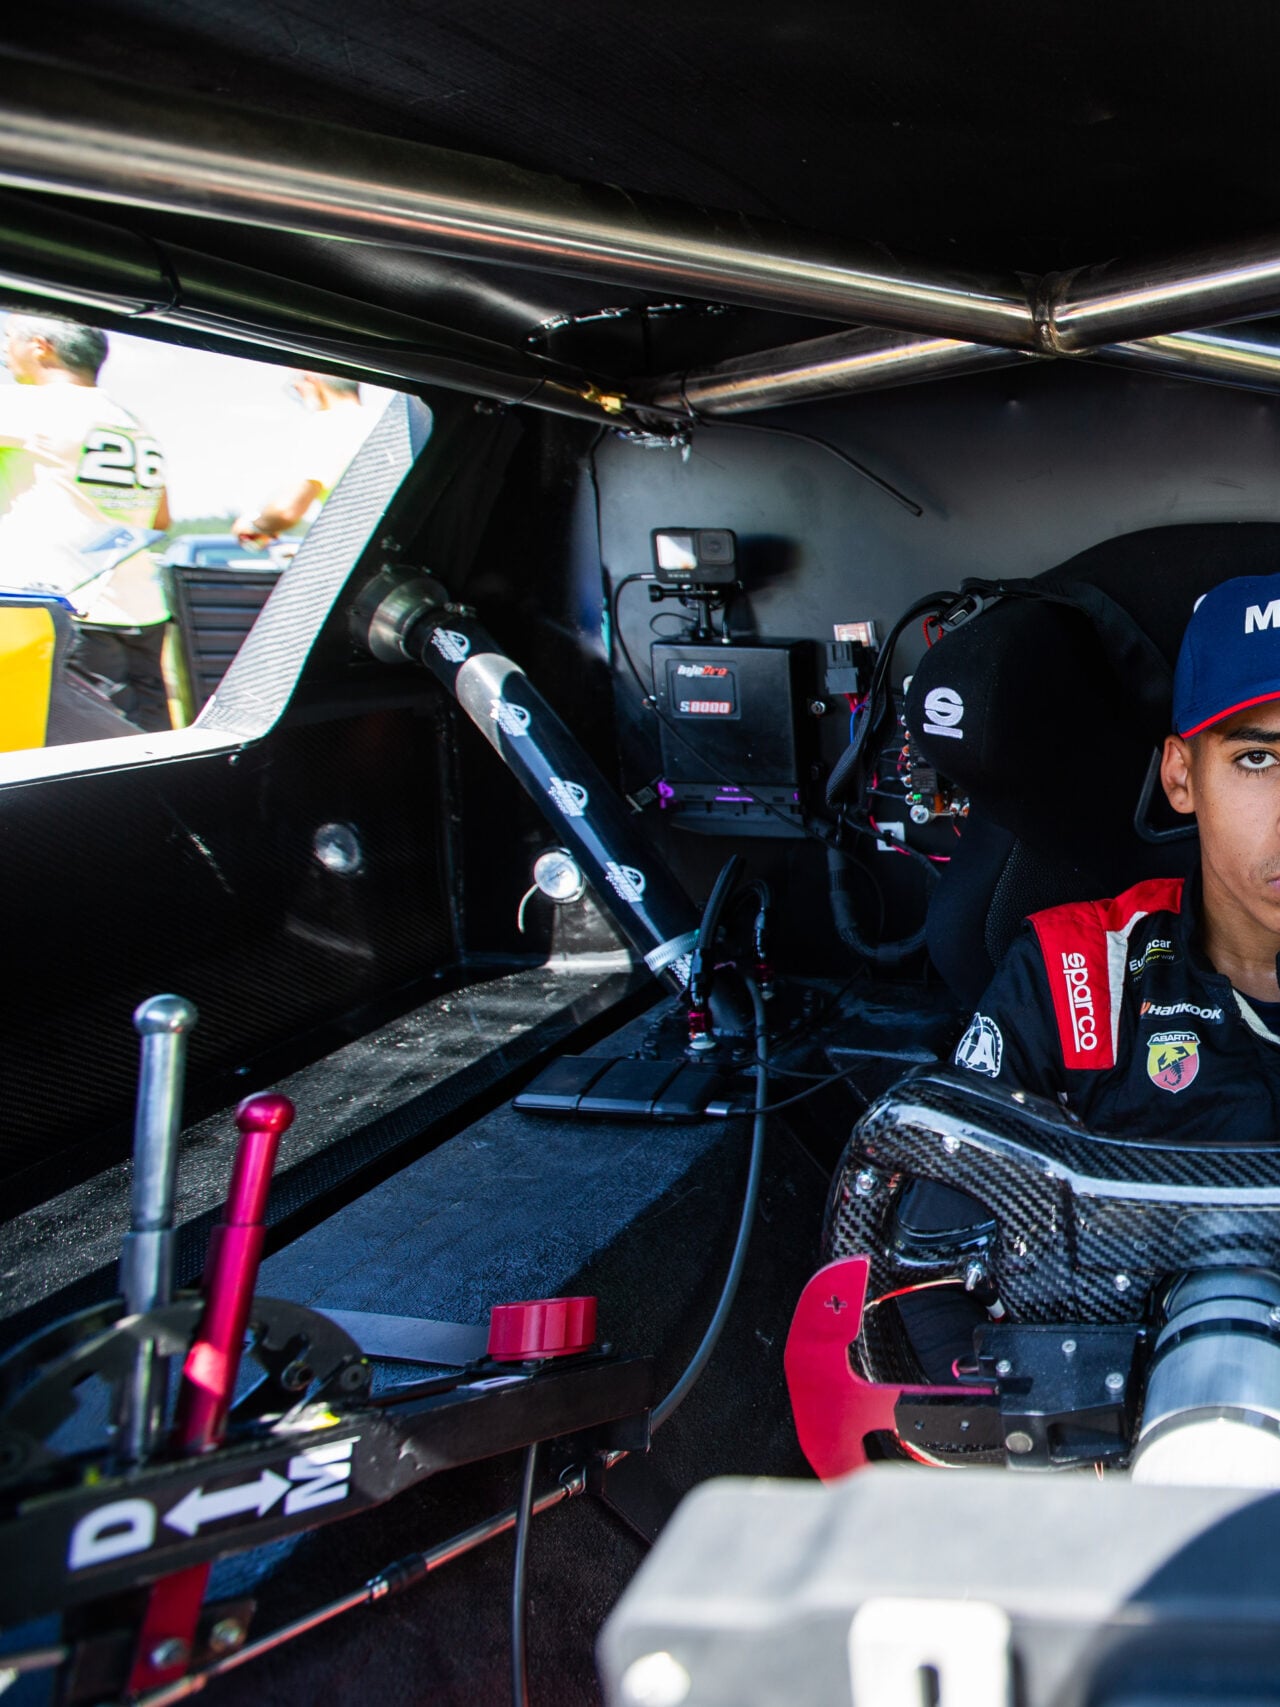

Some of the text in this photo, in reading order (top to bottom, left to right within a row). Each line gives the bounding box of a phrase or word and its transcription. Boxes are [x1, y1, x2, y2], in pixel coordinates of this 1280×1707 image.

[77, 427, 166, 489] 26
[1062, 952, 1098, 1052] sparco
[1152, 1034, 1196, 1043] ABARTH
[67, 1435, 361, 1571] D M
